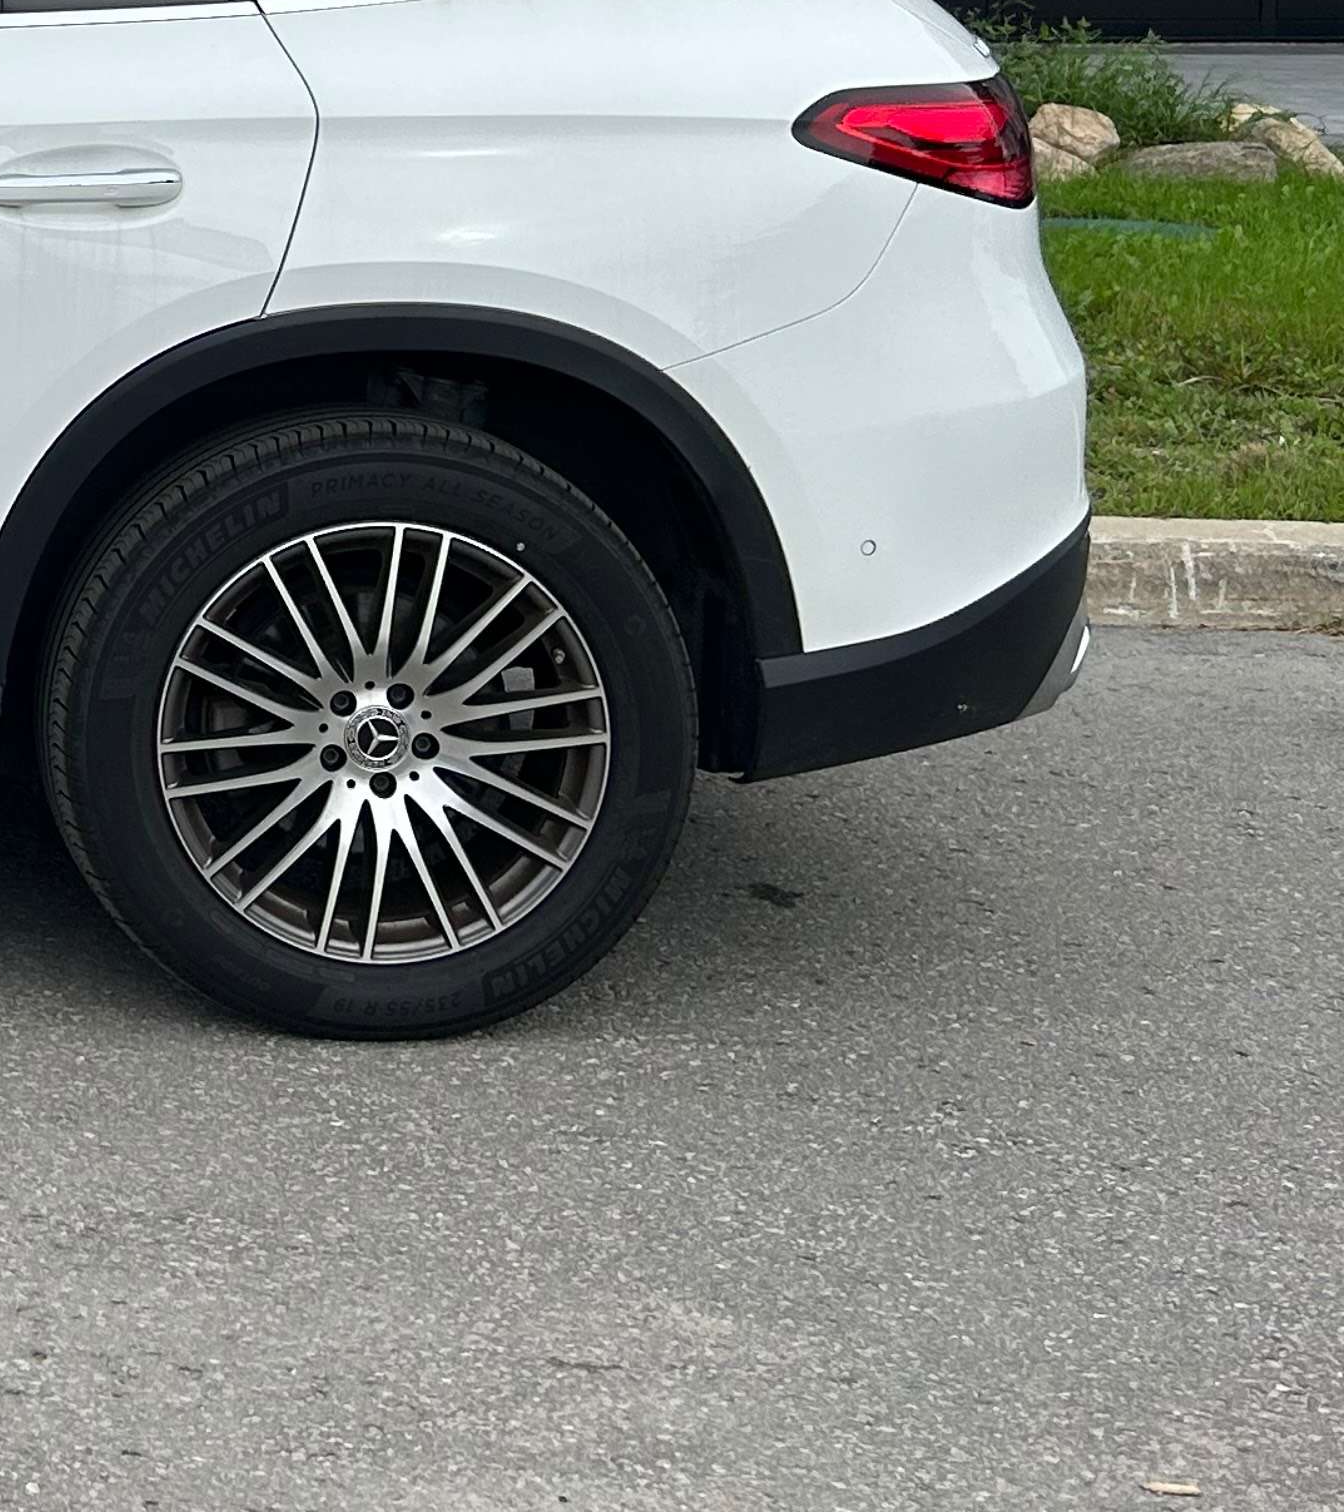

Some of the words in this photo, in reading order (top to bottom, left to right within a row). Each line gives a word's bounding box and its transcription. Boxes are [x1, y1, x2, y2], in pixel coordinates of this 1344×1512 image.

[311, 471, 410, 499] PRIMACY
[138, 490, 282, 629] MICHELIN
[490, 865, 634, 997] MICHELIN
